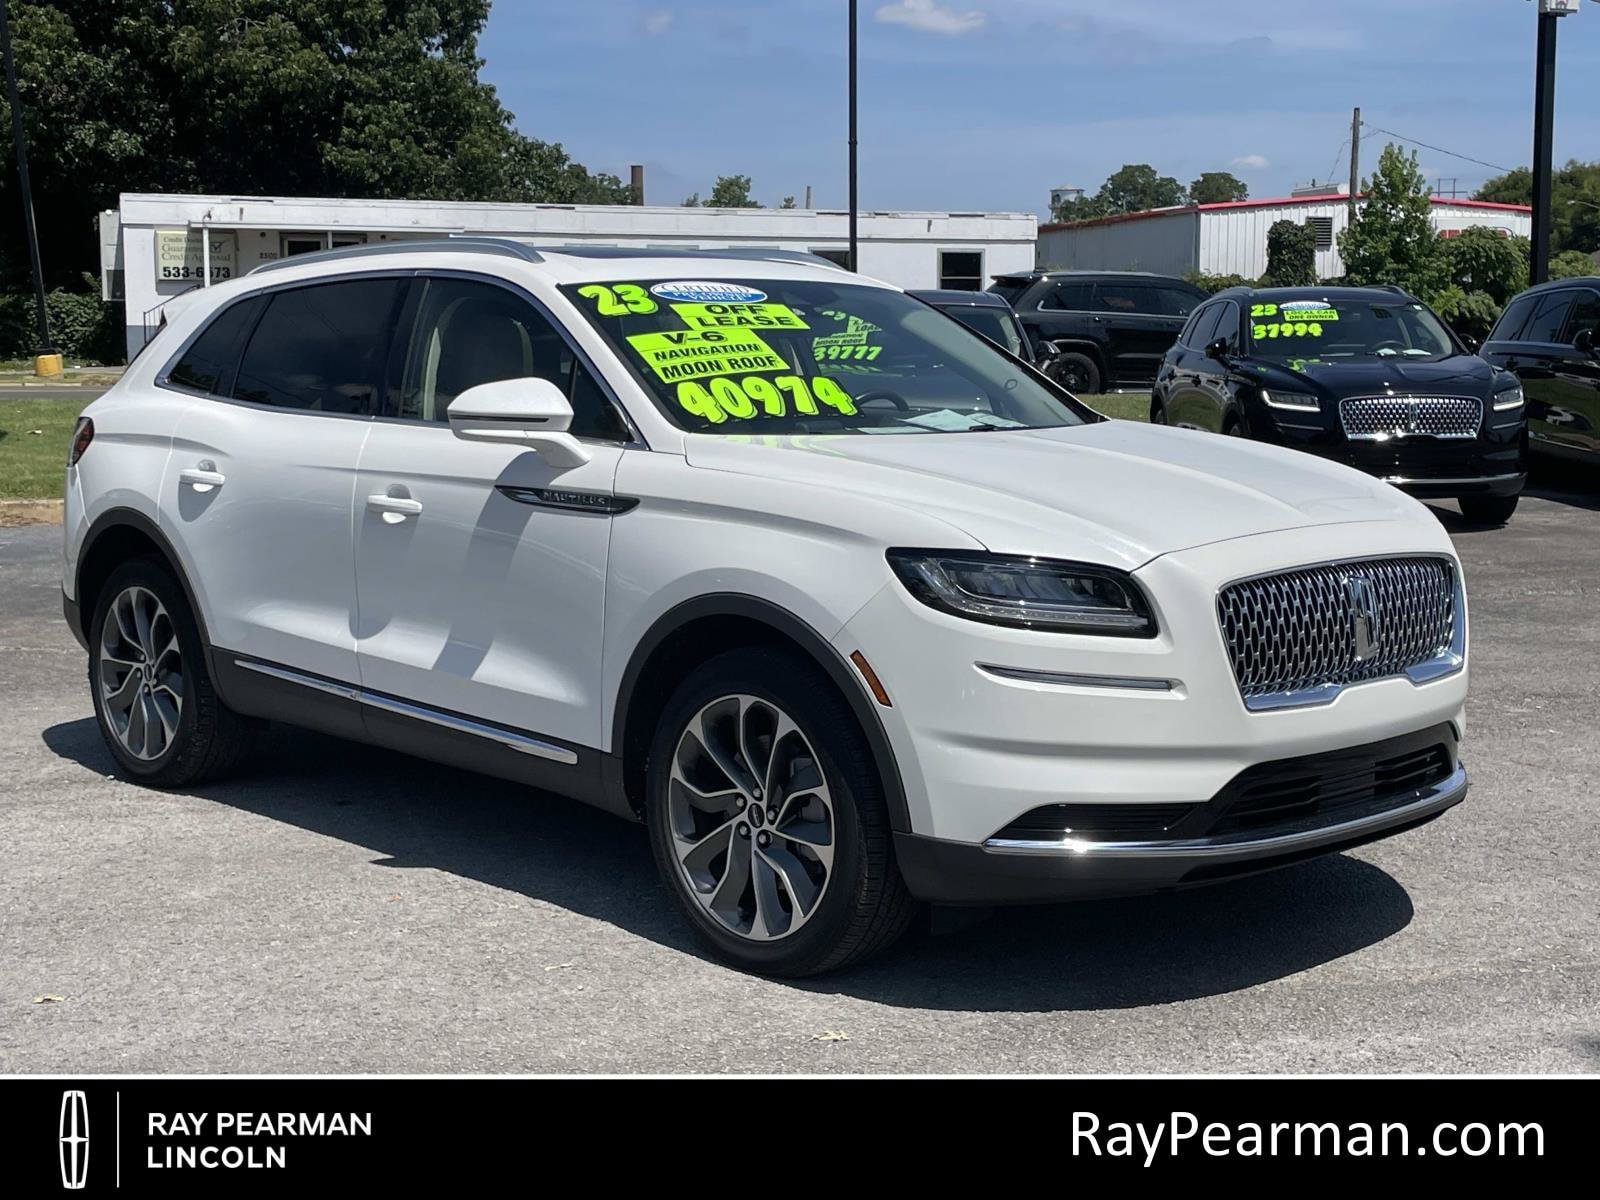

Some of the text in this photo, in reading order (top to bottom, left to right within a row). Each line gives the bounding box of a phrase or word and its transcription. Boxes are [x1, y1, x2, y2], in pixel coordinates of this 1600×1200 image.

[578, 284, 658, 316] 23
[704, 304, 766, 316] OFF
[1251, 304, 1278, 316] 23
[696, 316, 797, 328] LEASE
[661, 331, 728, 345] V-6
[653, 343, 763, 361] NAVIGATION
[814, 345, 882, 361] 39777
[660, 355, 780, 379] MOON ROOF
[677, 376, 857, 424] 40974
[543, 491, 605, 505] NAUTILUS
